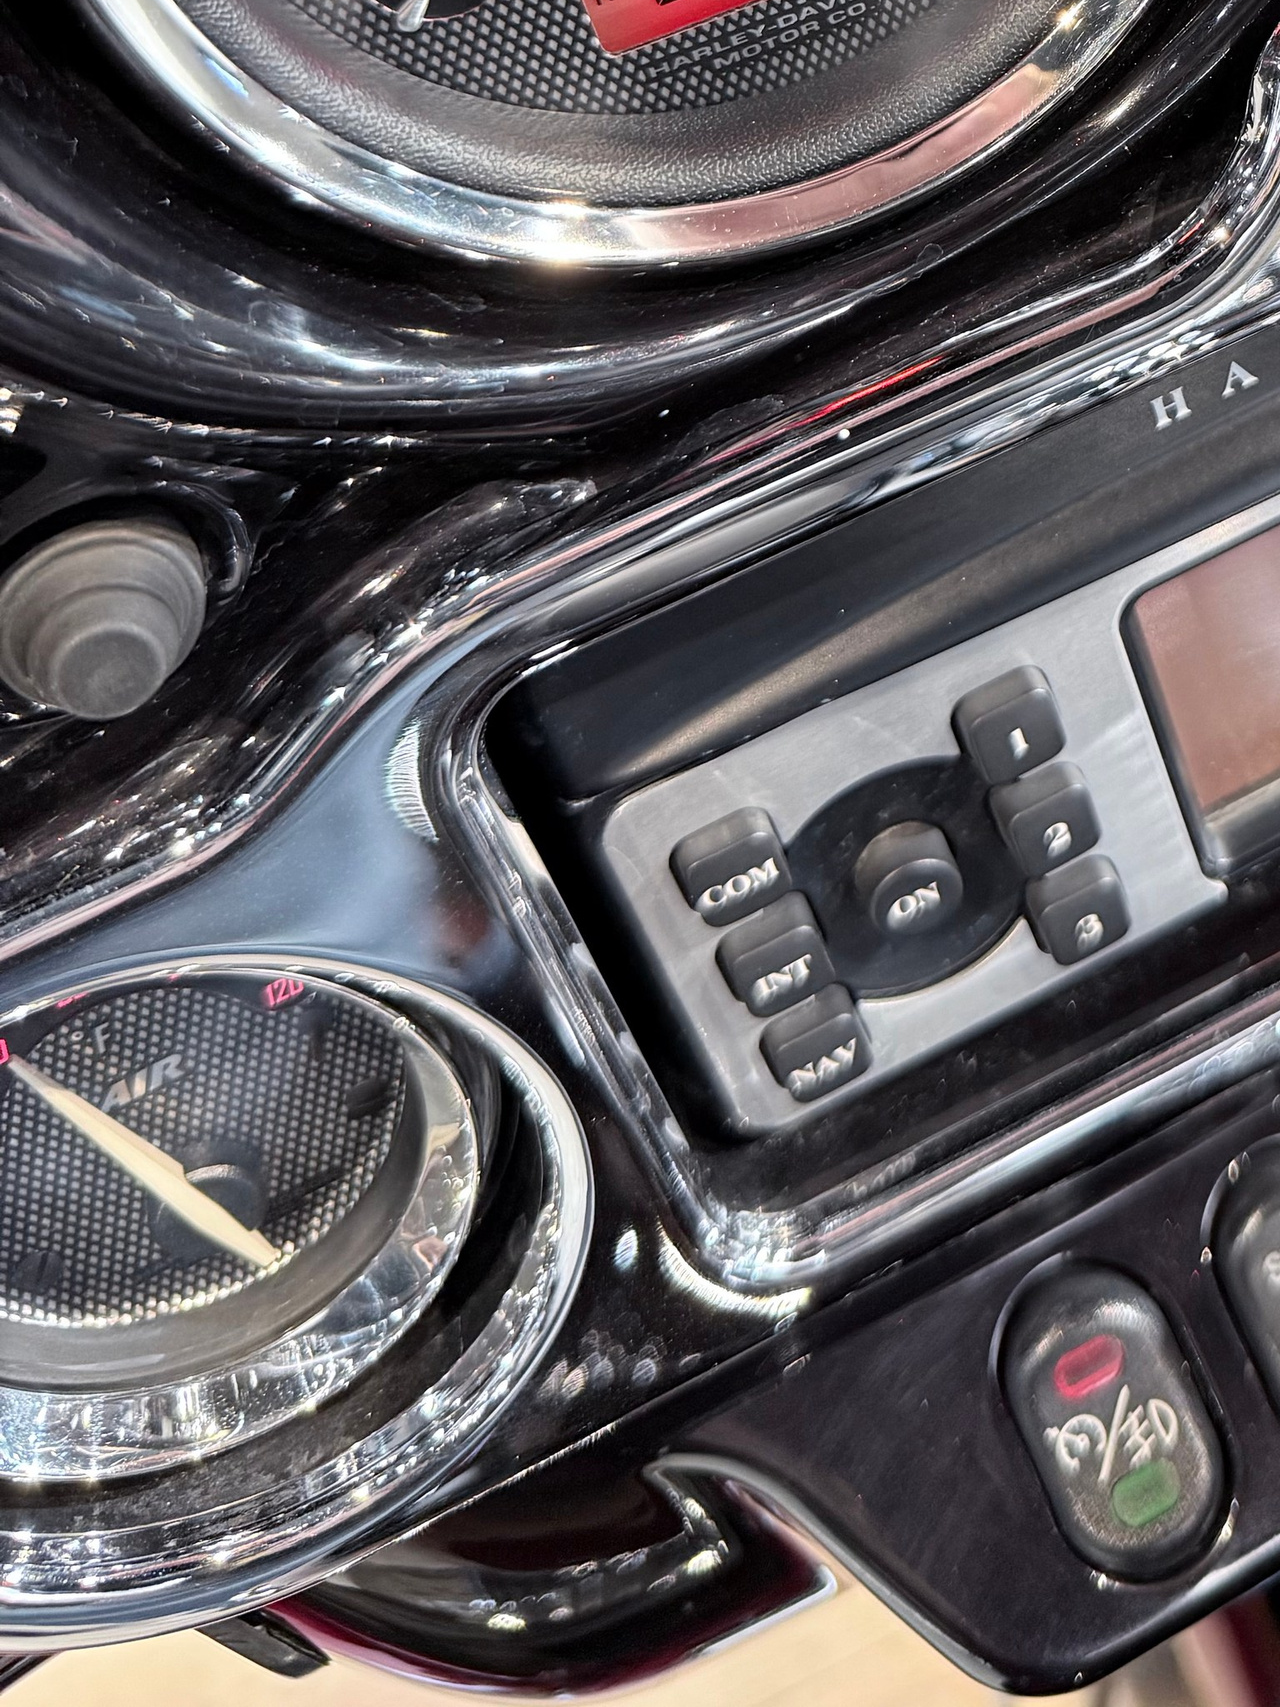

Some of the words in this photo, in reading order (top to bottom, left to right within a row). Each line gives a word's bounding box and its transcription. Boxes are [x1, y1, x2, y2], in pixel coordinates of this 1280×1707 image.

[714, 23, 822, 70] MOTOR
[1007, 726, 1030, 759] 1
[1043, 821, 1073, 856] 2
[699, 858, 779, 911] COM
[889, 882, 941, 930] ON
[1075, 912, 1105, 947] 3
[752, 954, 813, 1006] INT
[101, 1053, 186, 1114] AIR
[787, 1038, 860, 1094] NAV
